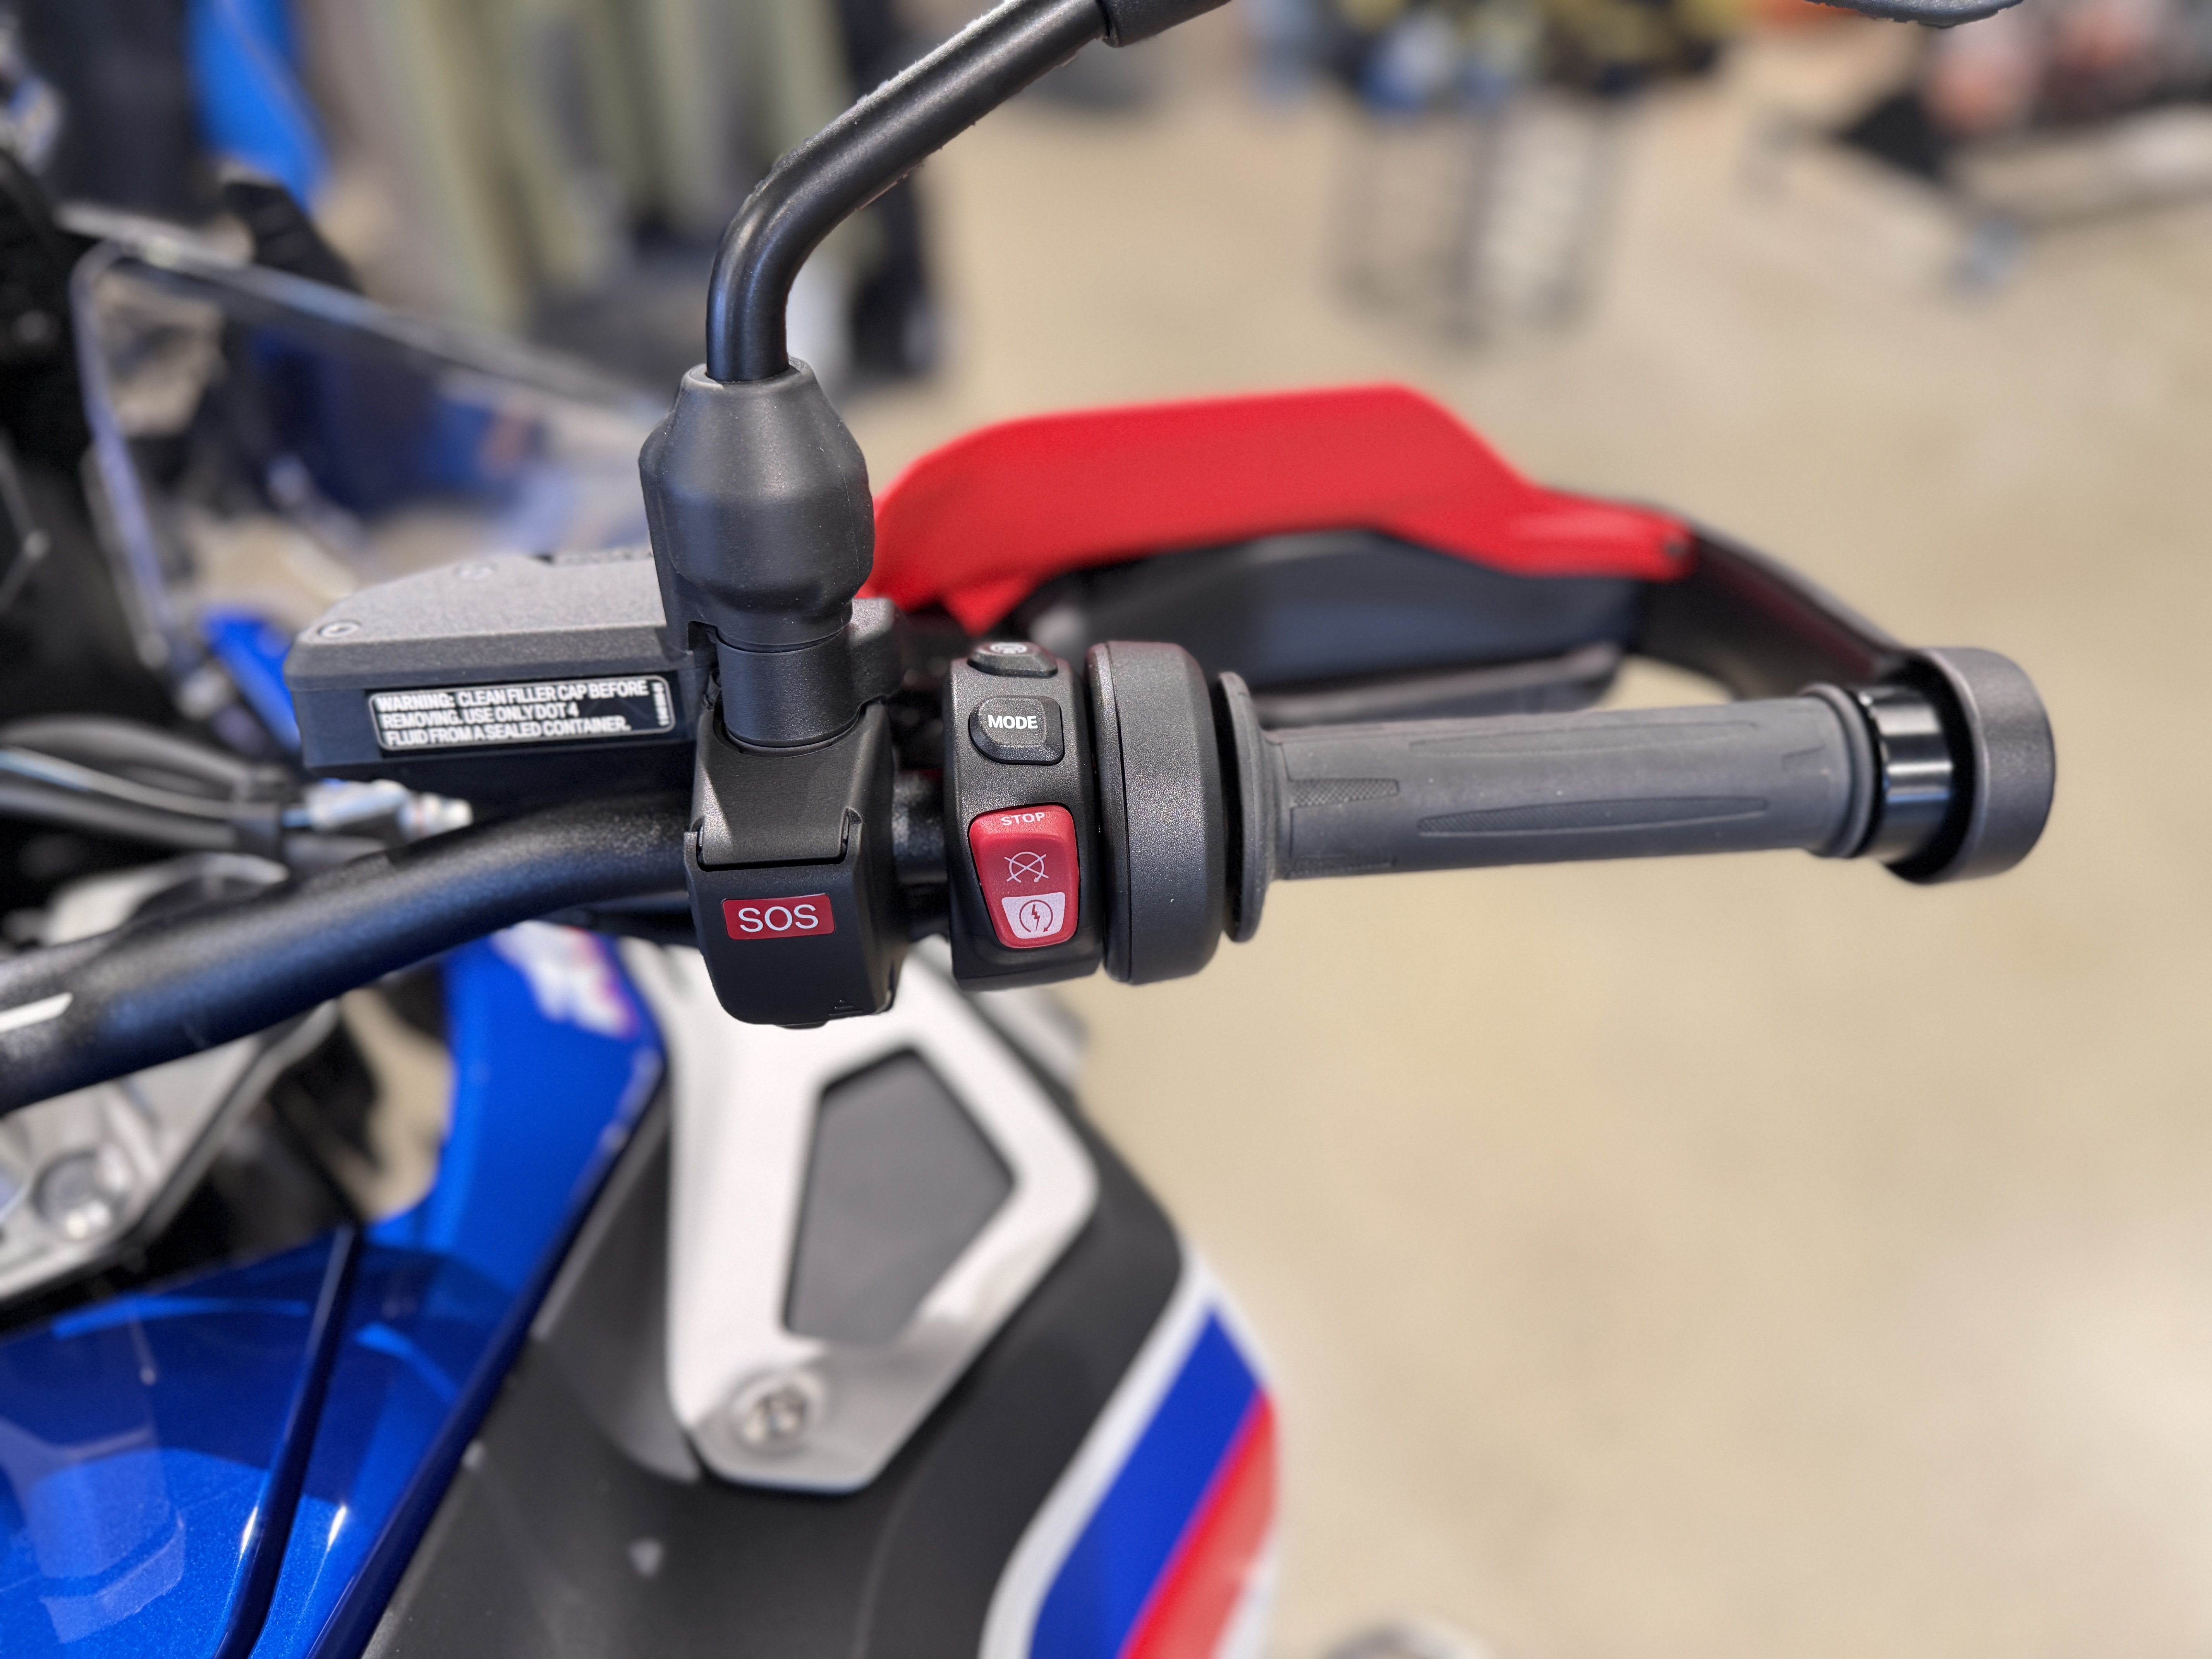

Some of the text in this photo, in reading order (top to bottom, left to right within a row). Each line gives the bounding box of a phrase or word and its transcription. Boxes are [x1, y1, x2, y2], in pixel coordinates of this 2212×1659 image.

[377, 680, 649, 711] WARNING: CLEAN FILLER CAP BEFORE
[380, 701, 579, 728] REMOVING. USE ONLY DOT 4
[988, 714, 1038, 729] MODE
[385, 716, 631, 746] FLUID FROM A SEALED CONTAINER.
[1001, 812, 1045, 826] STOP
[738, 904, 818, 932] SOS
